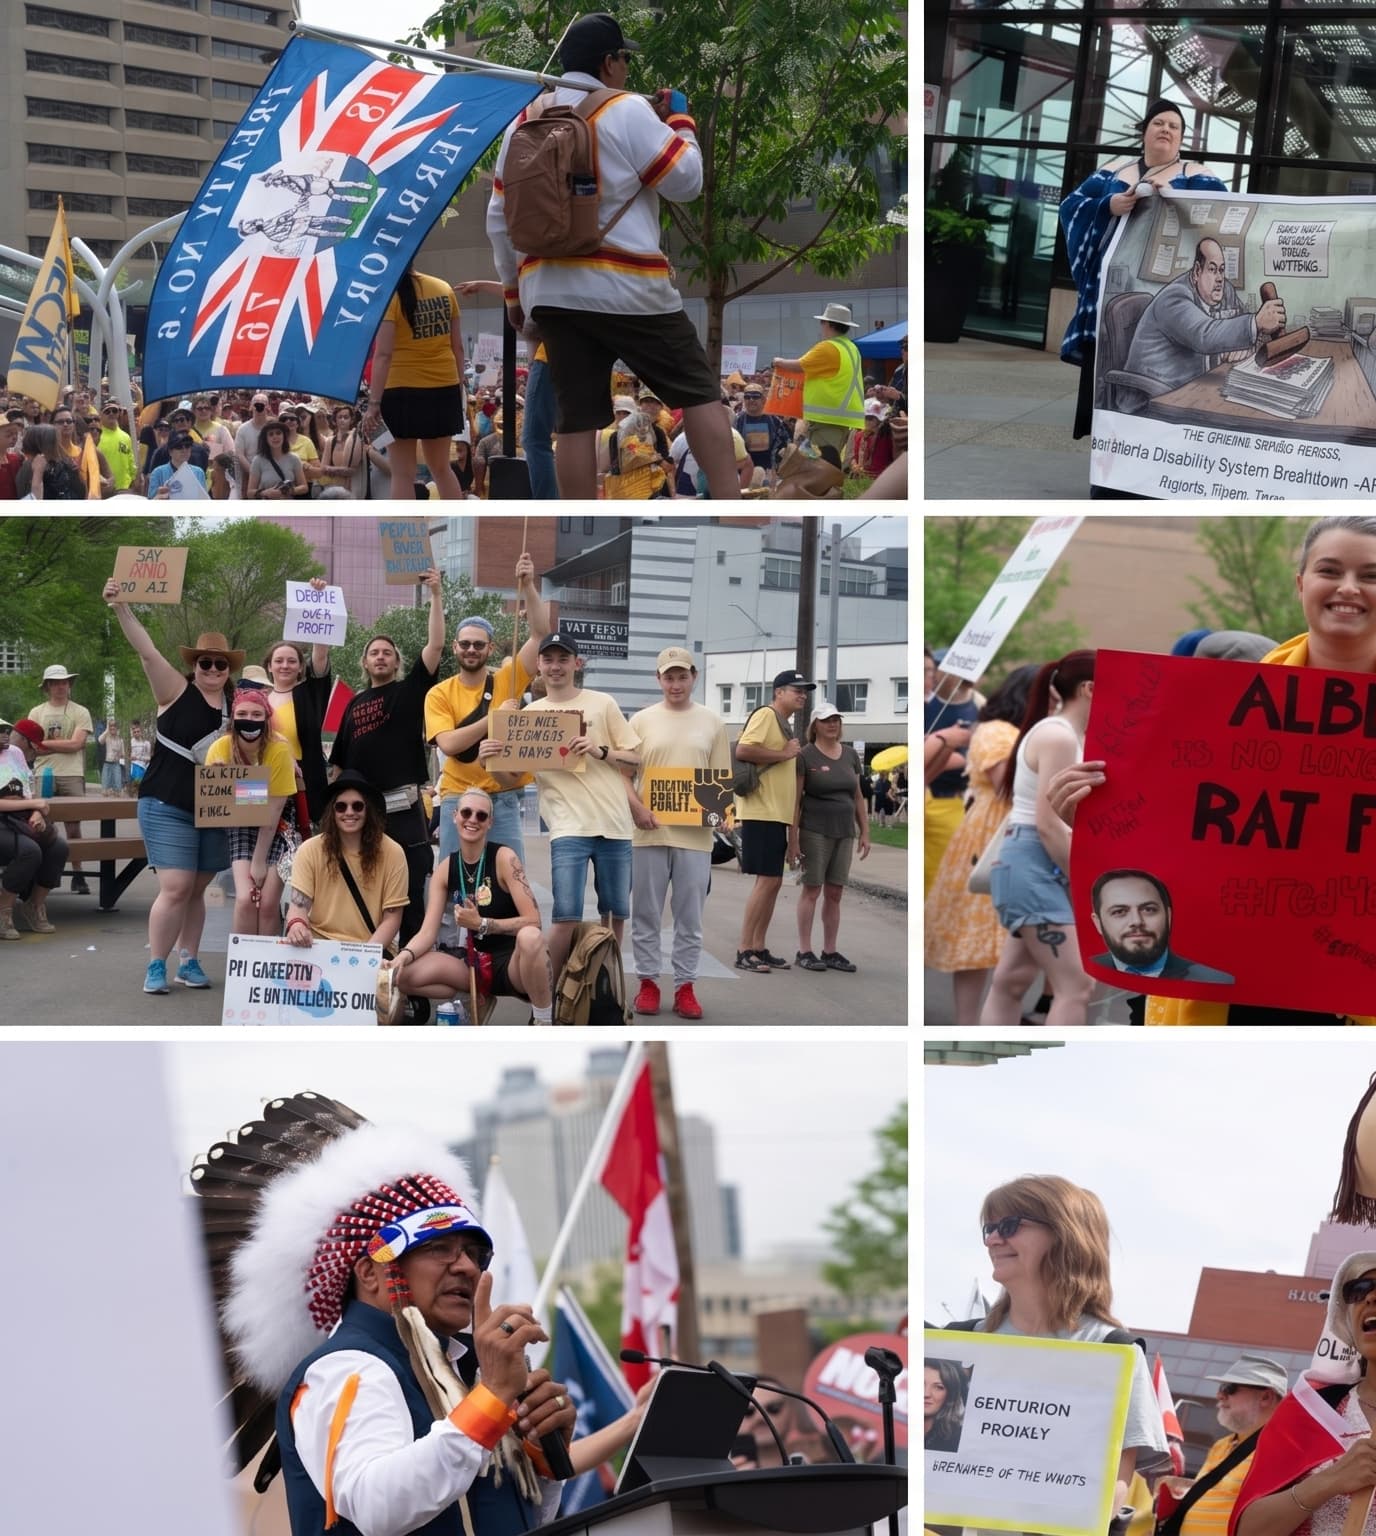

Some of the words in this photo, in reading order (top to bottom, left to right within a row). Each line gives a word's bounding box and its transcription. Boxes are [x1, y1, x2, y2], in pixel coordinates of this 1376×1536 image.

[1152, 446, 1216, 474] Disability
[1218, 457, 1269, 477] System
[136, 549, 163, 563] SAY
[1231, 739, 1282, 771] NO
[1191, 781, 1320, 850] RAT
[998, 1468, 1014, 1480] OF
[1017, 1469, 1041, 1483] THE
